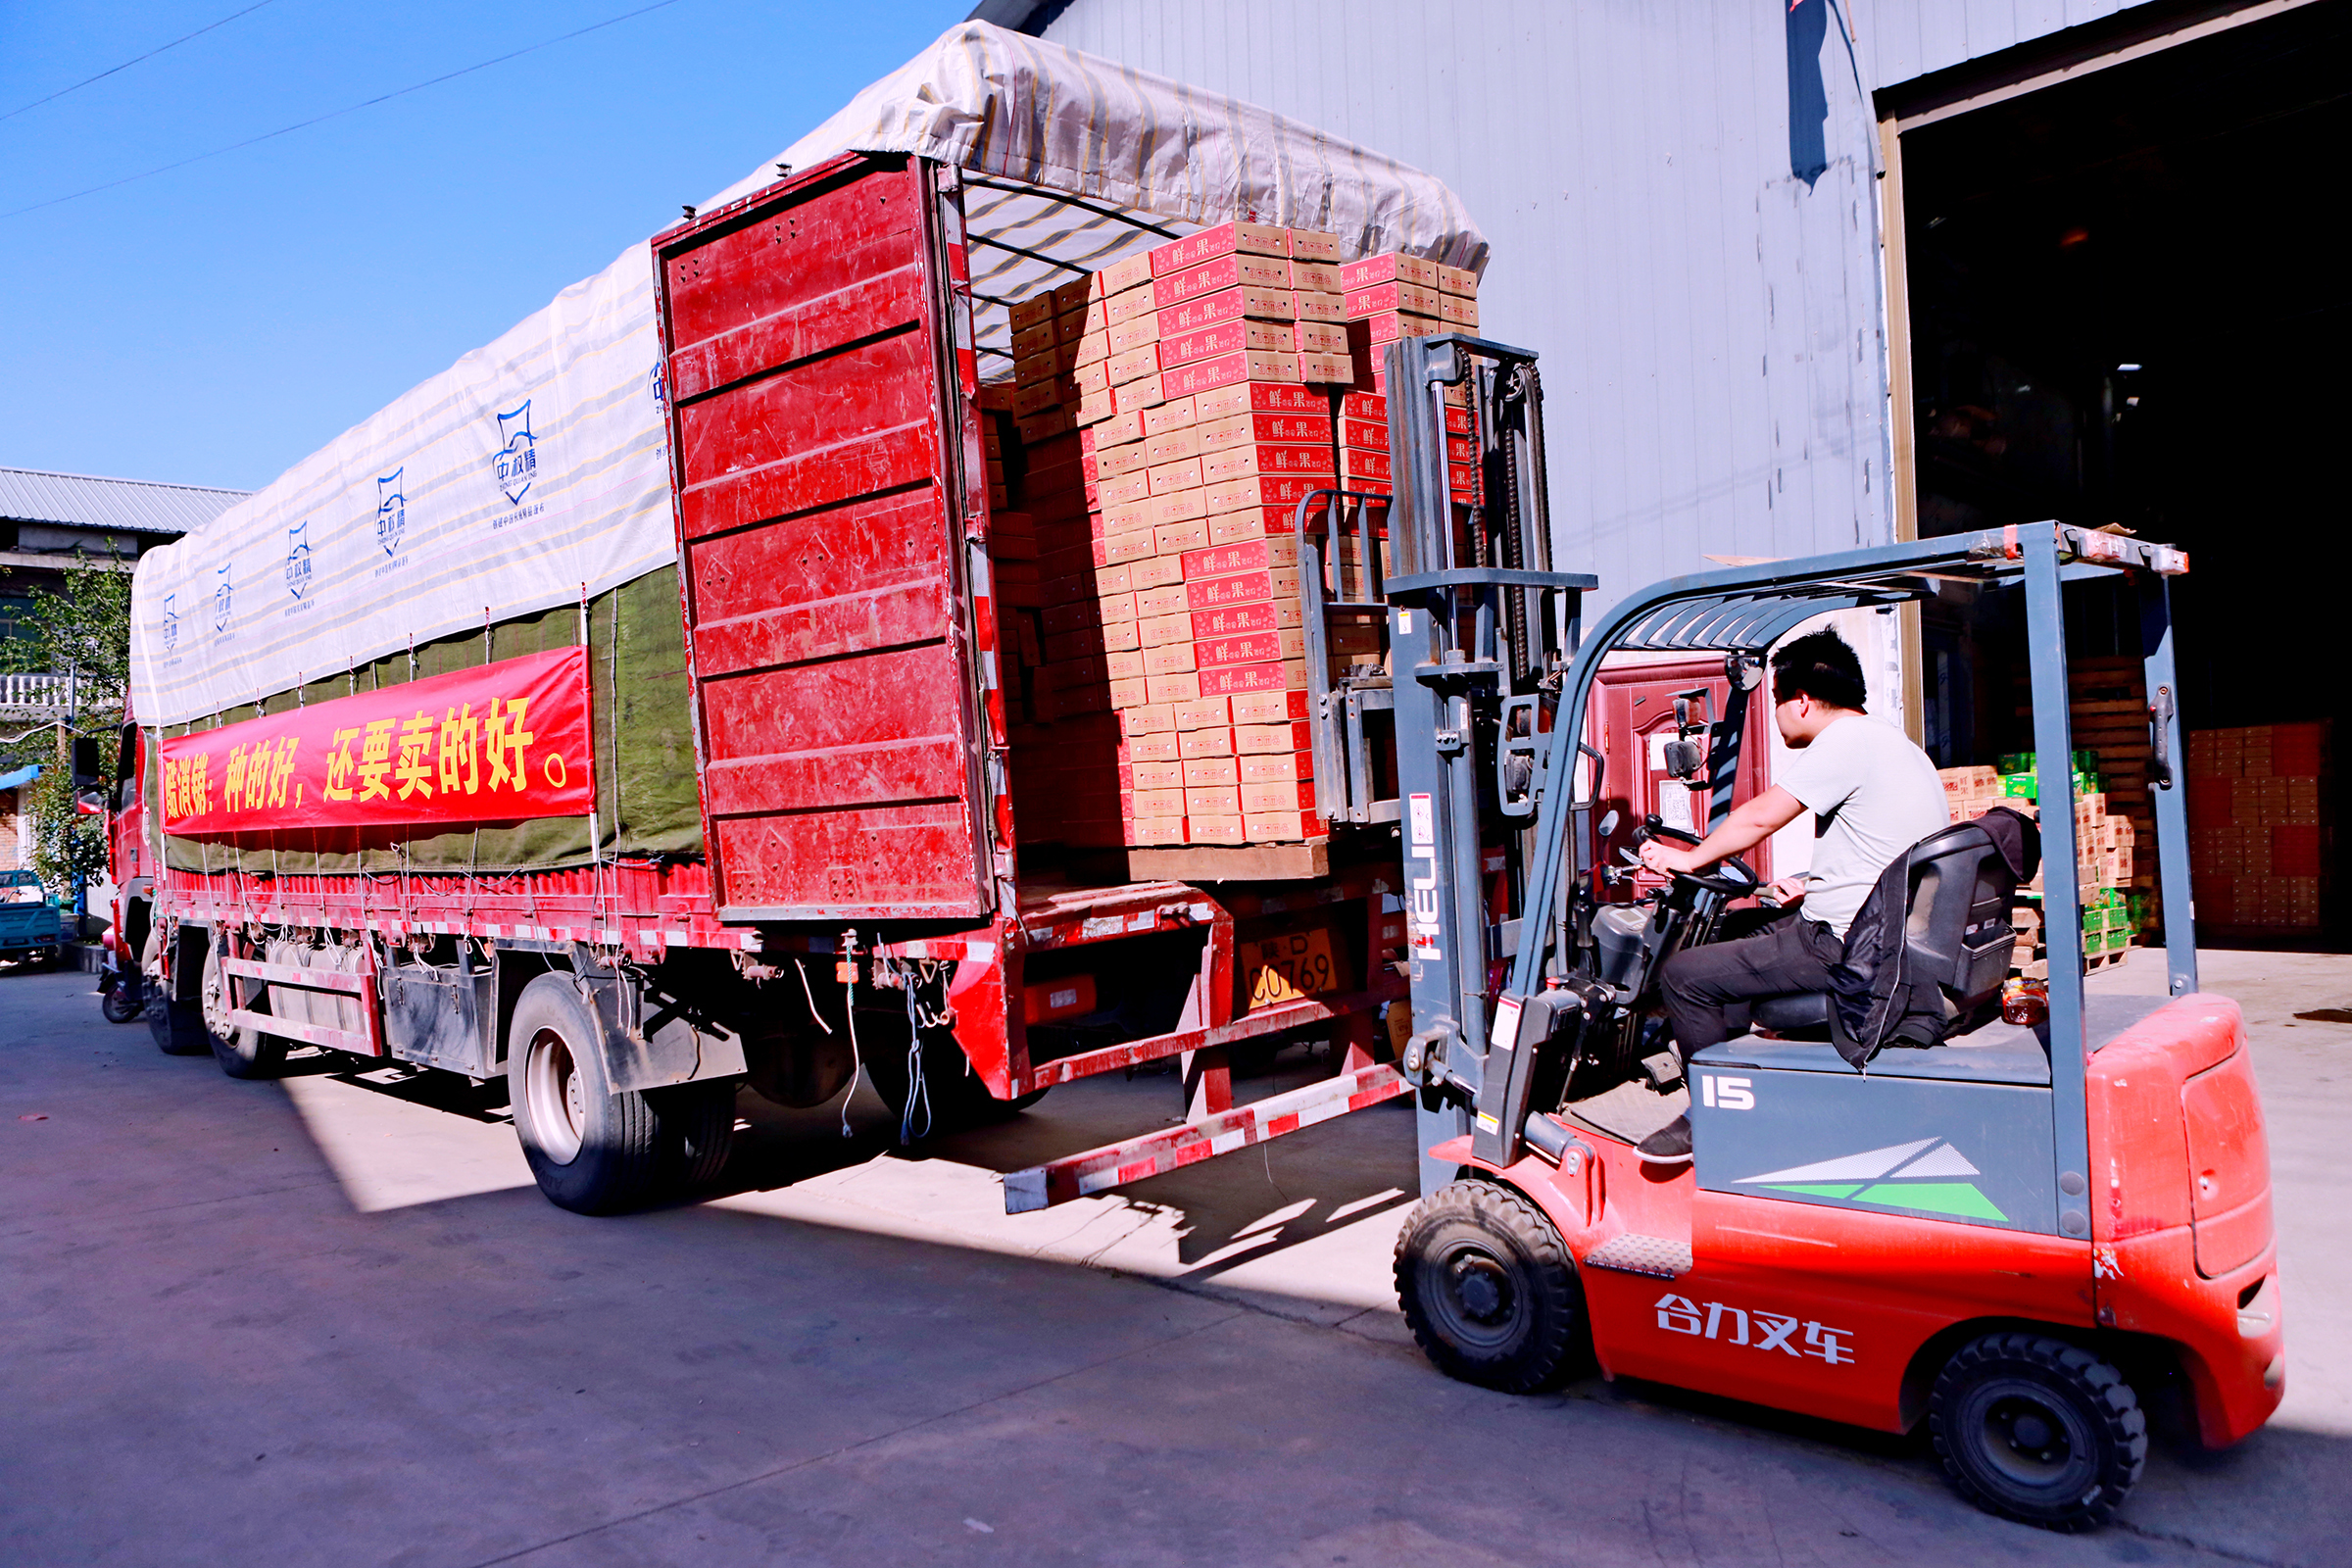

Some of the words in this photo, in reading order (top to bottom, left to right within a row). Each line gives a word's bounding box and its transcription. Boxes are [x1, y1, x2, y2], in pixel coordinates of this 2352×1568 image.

[497, 448, 537, 481] 中权精
[1411, 846, 1442, 960] HELI
[1250, 954, 1329, 1002] C0769
[1701, 1075, 1755, 1110] 15
[1654, 1292, 1855, 1365] 合力叉车
